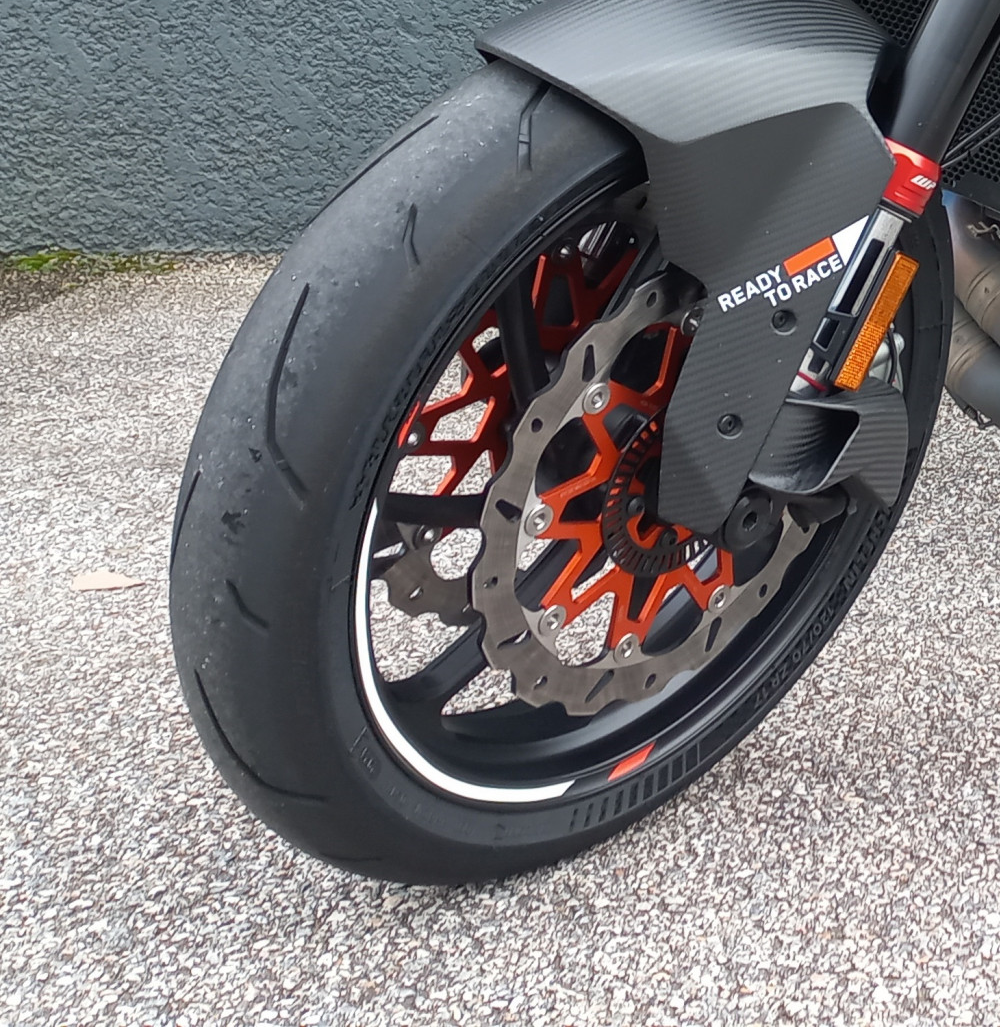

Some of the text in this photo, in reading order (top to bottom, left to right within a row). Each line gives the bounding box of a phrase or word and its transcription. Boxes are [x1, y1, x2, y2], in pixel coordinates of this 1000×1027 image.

[717, 265, 783, 312] READY
[764, 254, 844, 307] TO RACE
[791, 606, 834, 663] 120/70
[755, 687, 771, 709] 17
[770, 664, 789, 687] ZR
